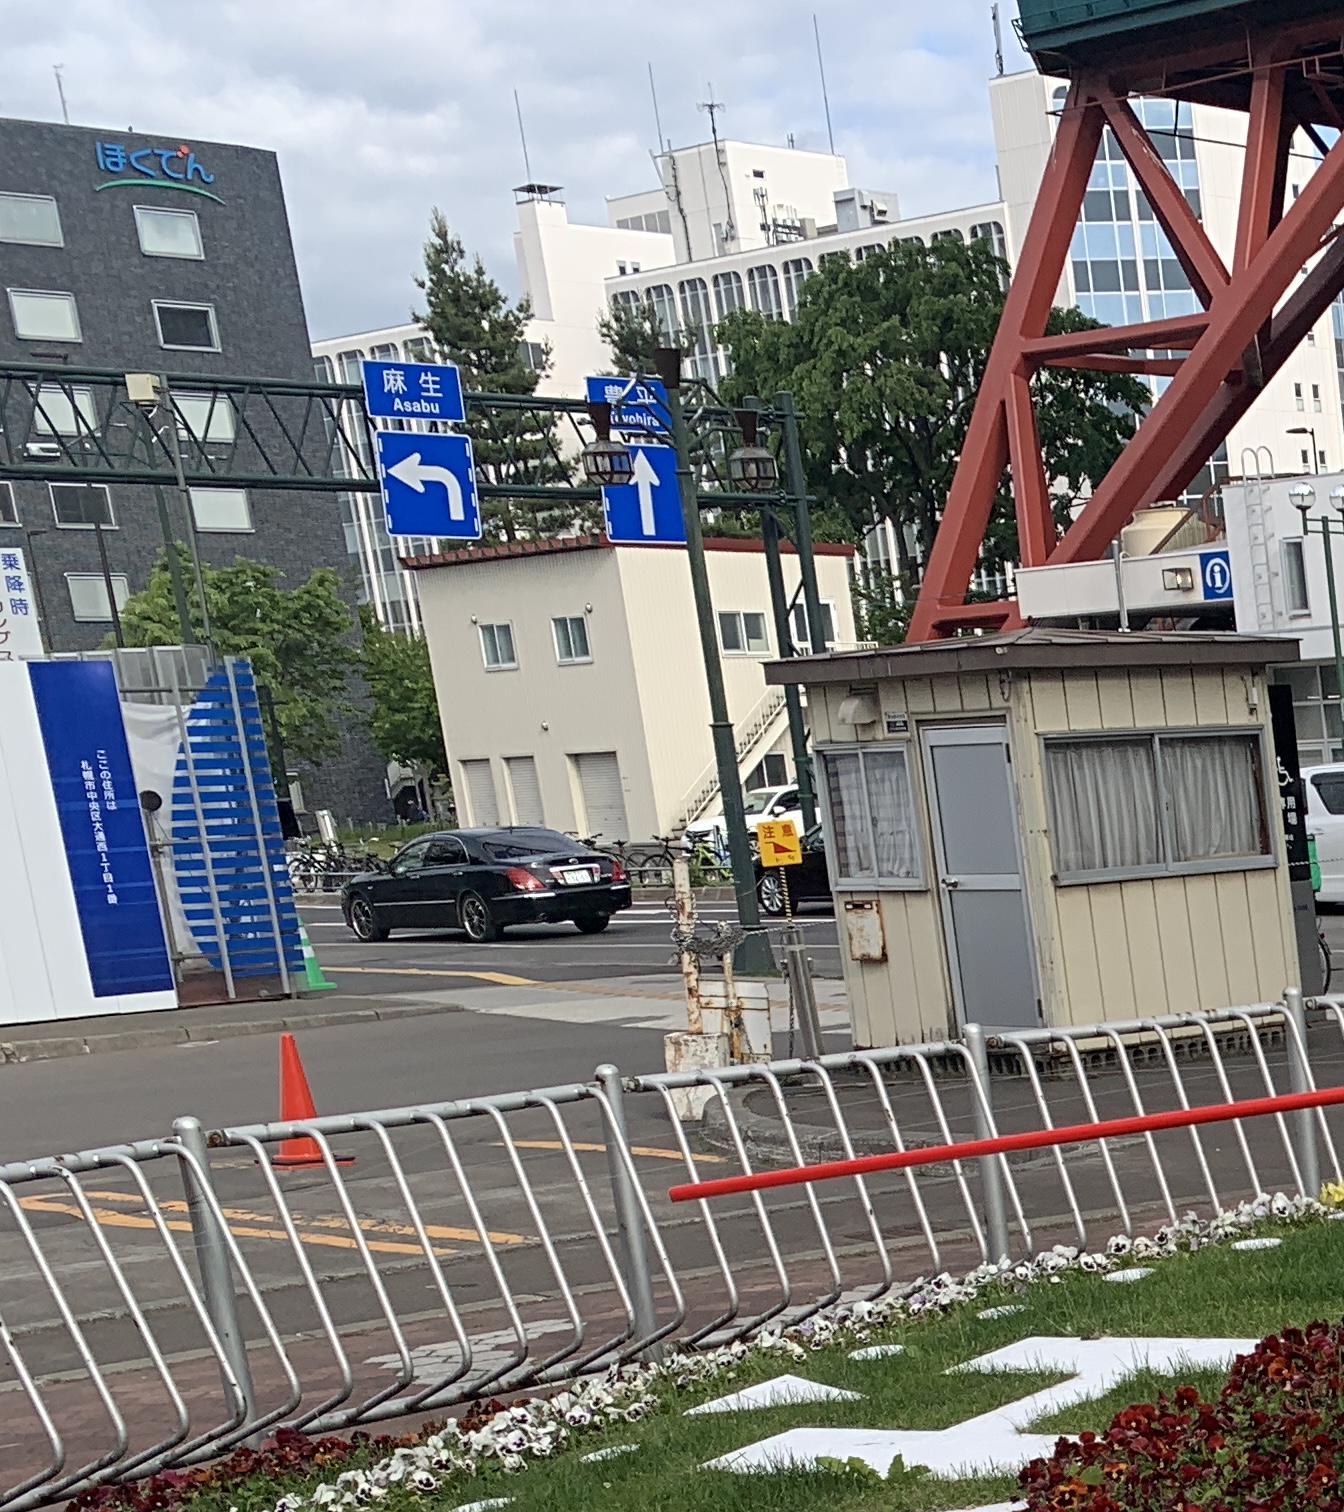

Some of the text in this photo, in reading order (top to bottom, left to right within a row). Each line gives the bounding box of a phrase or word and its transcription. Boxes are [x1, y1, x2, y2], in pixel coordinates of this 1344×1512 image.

[95, 141, 215, 184] ほくでん
[382, 368, 443, 397] 麻生
[393, 397, 440, 414] Asabu
[96, 750, 118, 810] ここの住所は
